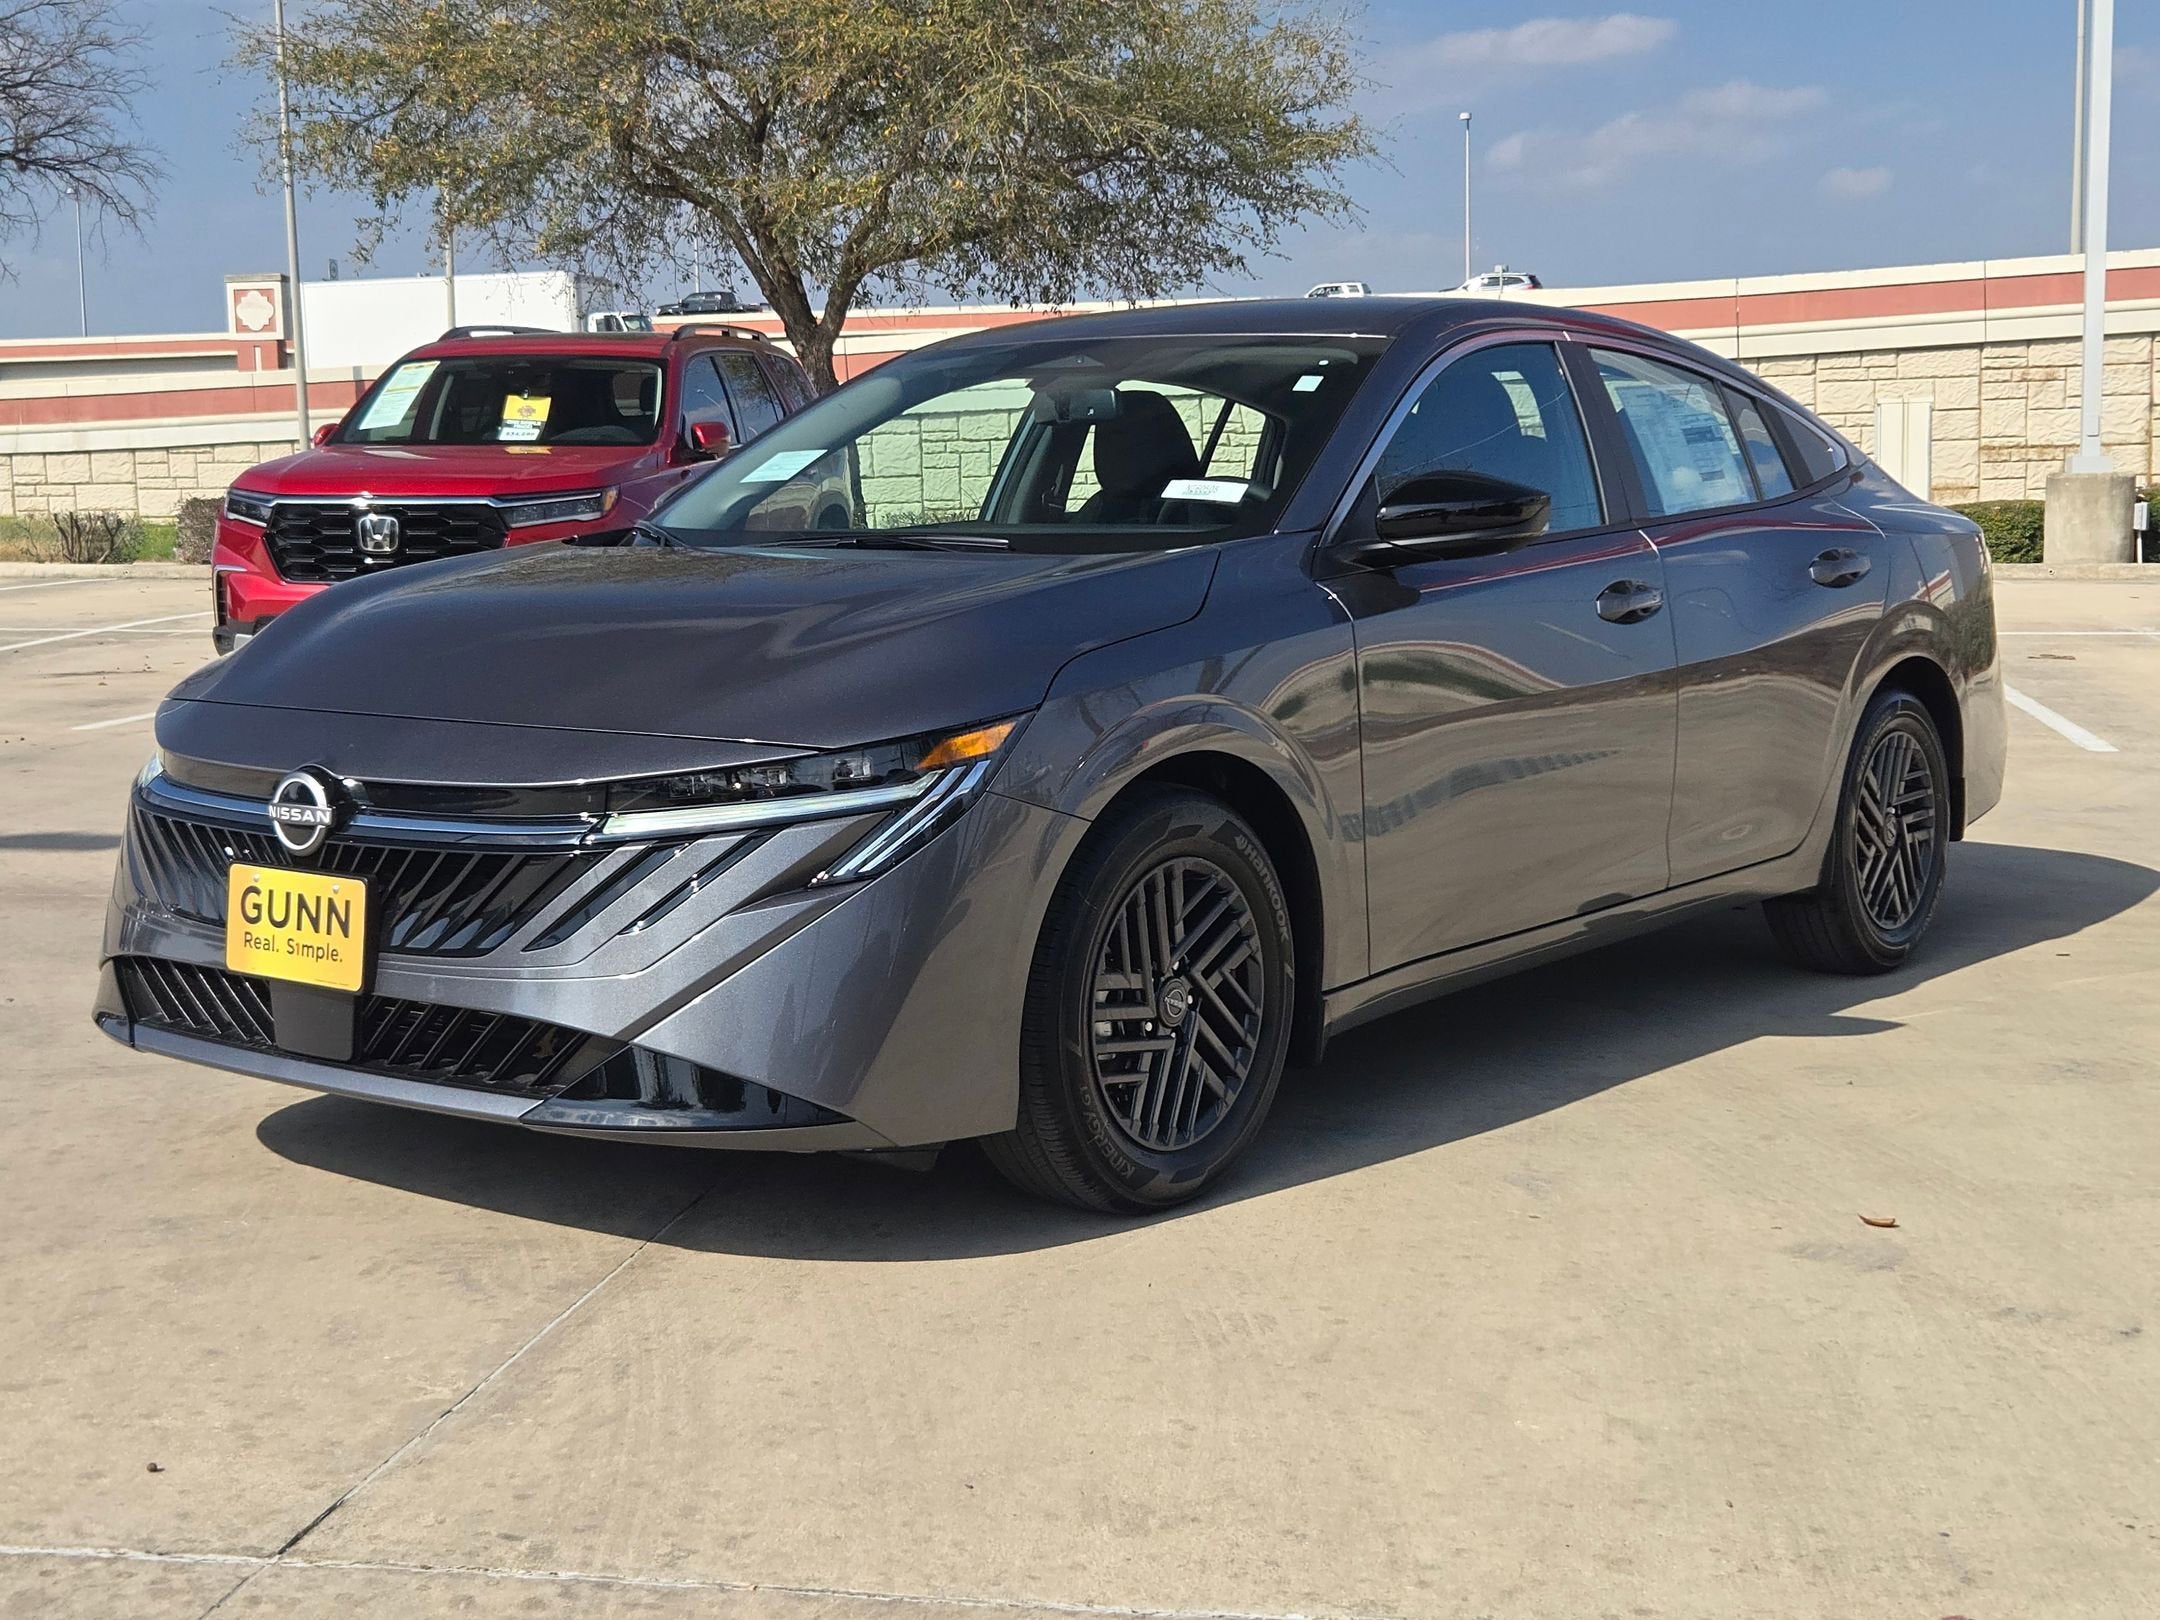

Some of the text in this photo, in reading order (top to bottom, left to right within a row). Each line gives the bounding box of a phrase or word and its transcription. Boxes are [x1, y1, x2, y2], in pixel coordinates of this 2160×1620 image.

[268, 805, 330, 823] NISSAN
[240, 885, 351, 938] GUNN
[243, 931, 279, 952] Real.
